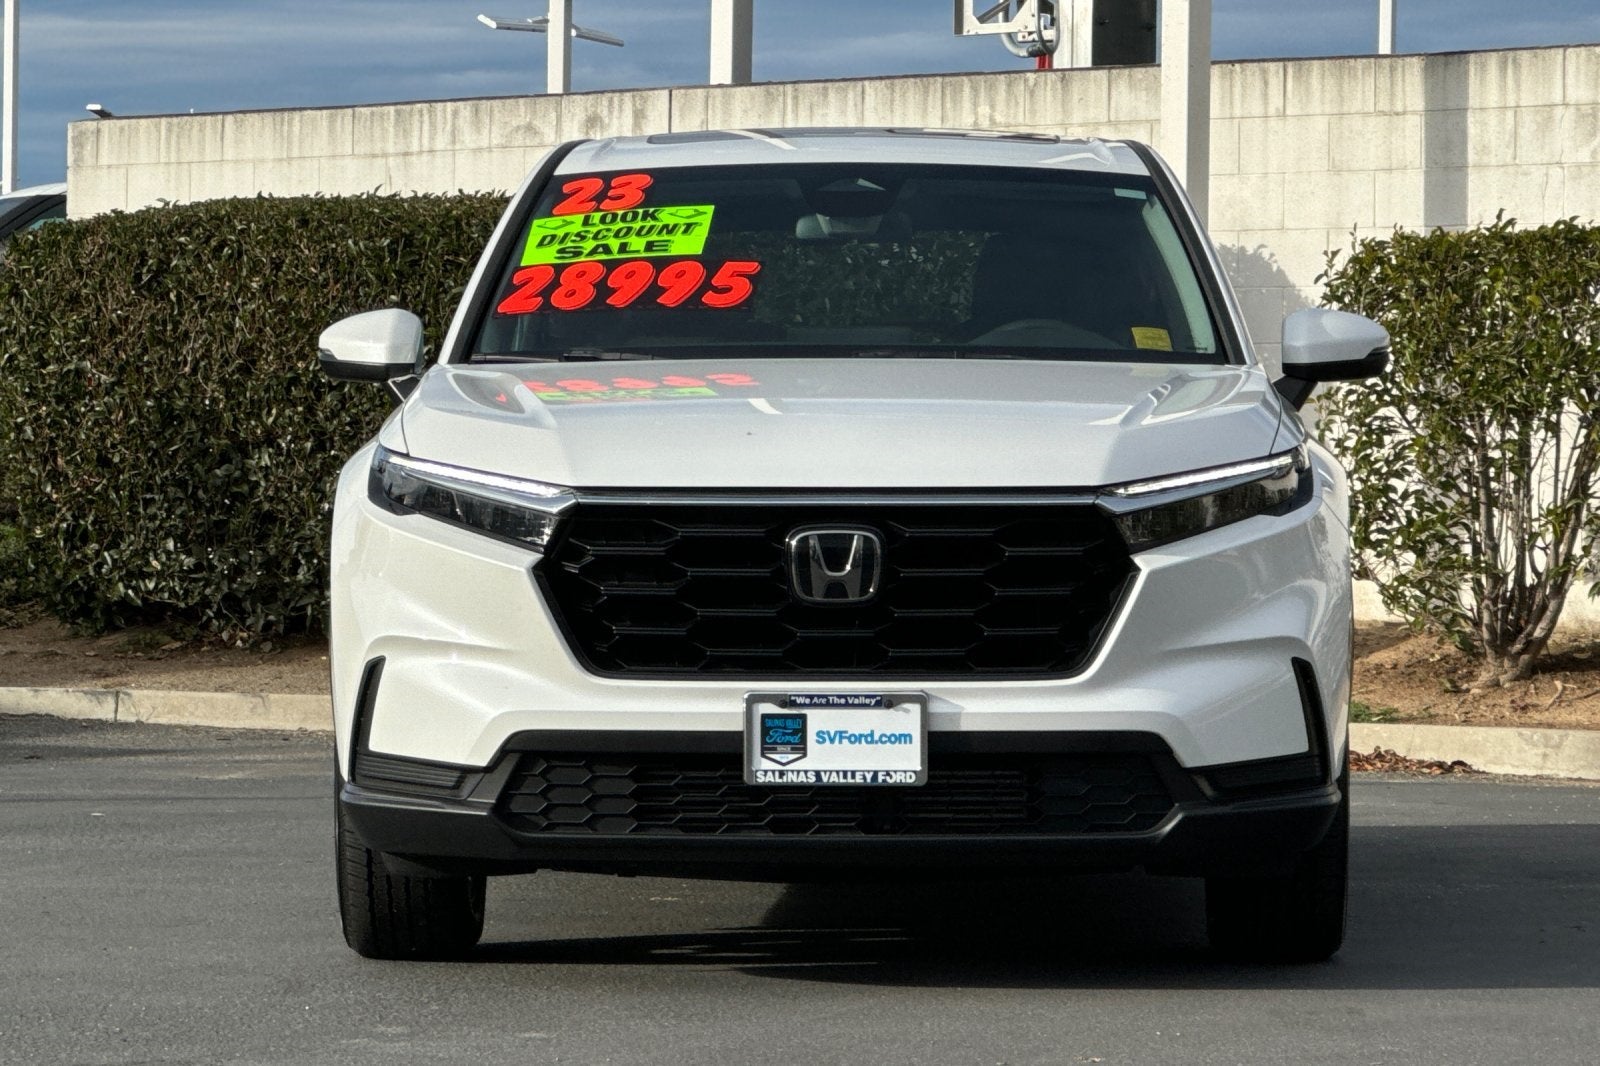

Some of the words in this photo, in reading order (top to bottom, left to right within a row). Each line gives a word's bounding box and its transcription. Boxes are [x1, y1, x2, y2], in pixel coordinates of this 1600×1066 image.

[552, 174, 654, 216] 23
[580, 208, 662, 229] LOOK
[535, 221, 703, 250] DISCOUNT
[553, 239, 675, 260] SALE
[497, 260, 762, 315] 28995
[812, 696, 827, 705] Are
[828, 696, 846, 704] The
[765, 728, 802, 743] Ford
[815, 729, 913, 745] SVFord.com
[756, 770, 817, 783] SALINAS
[820, 770, 874, 783] VALLEY
[877, 771, 916, 784] FORD
